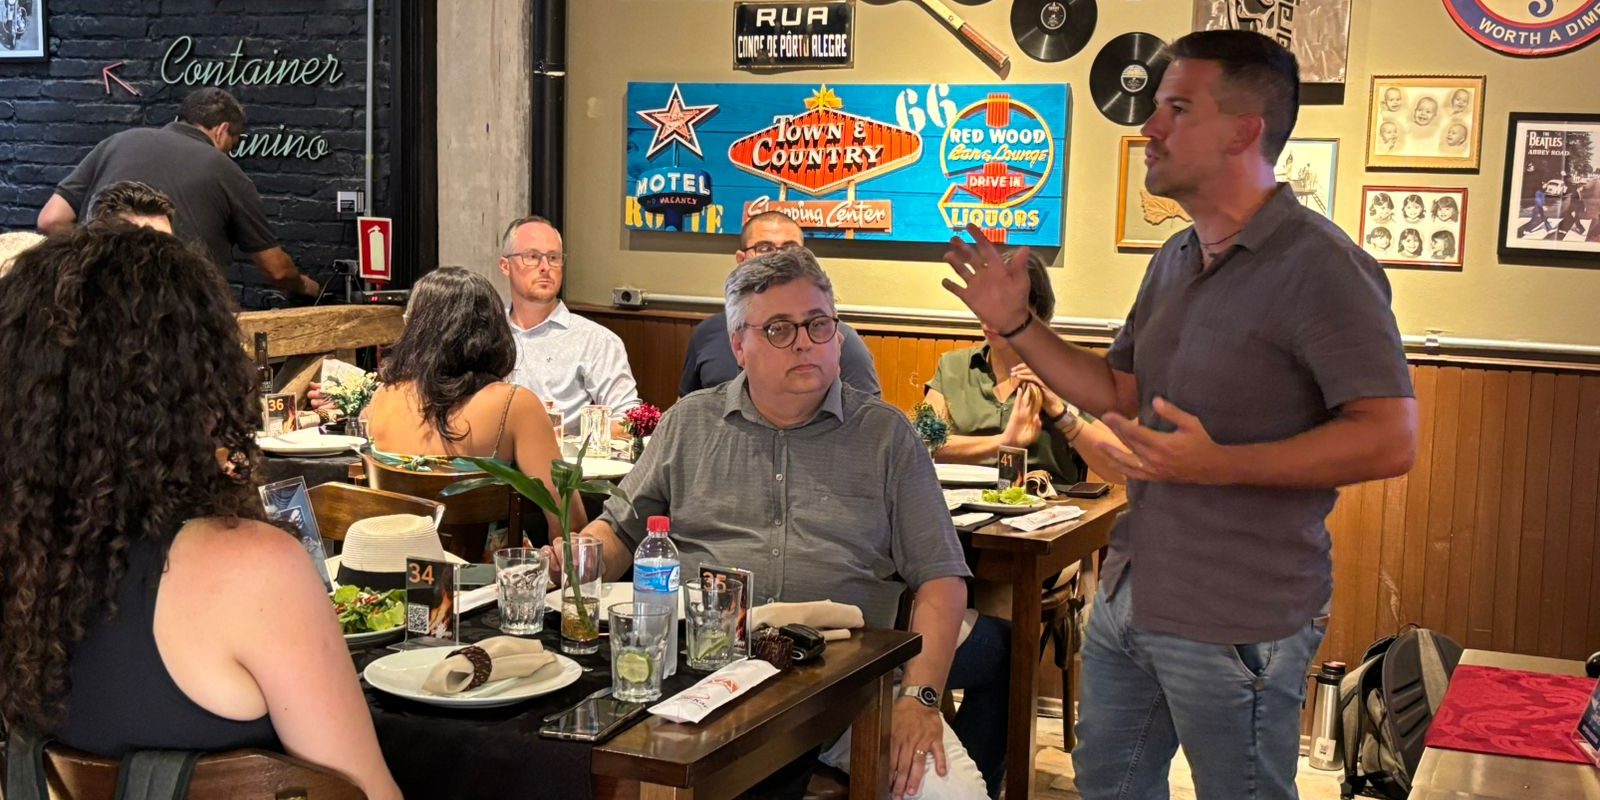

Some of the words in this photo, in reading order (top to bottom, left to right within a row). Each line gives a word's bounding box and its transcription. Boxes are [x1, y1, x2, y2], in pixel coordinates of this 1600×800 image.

[756, 7, 828, 27] RUA
[1479, 17, 1541, 45] WORTH
[1549, 29, 1561, 42] A
[766, 35, 778, 57] DE
[812, 34, 847, 57] ALEGRE
[161, 35, 343, 86] Container
[896, 84, 958, 132] 66
[950, 128, 984, 144] RED
[989, 128, 1046, 144] WOOD
[1529, 131, 1563, 149] BEATLES
[948, 143, 981, 160] Bar
[991, 143, 1048, 168] Lounge
[636, 172, 711, 197] MOTEL
[969, 176, 1006, 187] DRIVE
[660, 196, 697, 205] VACANCY
[826, 200, 885, 228] Center
[951, 208, 1039, 228] LIQUORS
[268, 398, 284, 412] 36
[1000, 453, 1013, 468] 41
[408, 563, 434, 585] 34
[702, 571, 727, 593] 35
